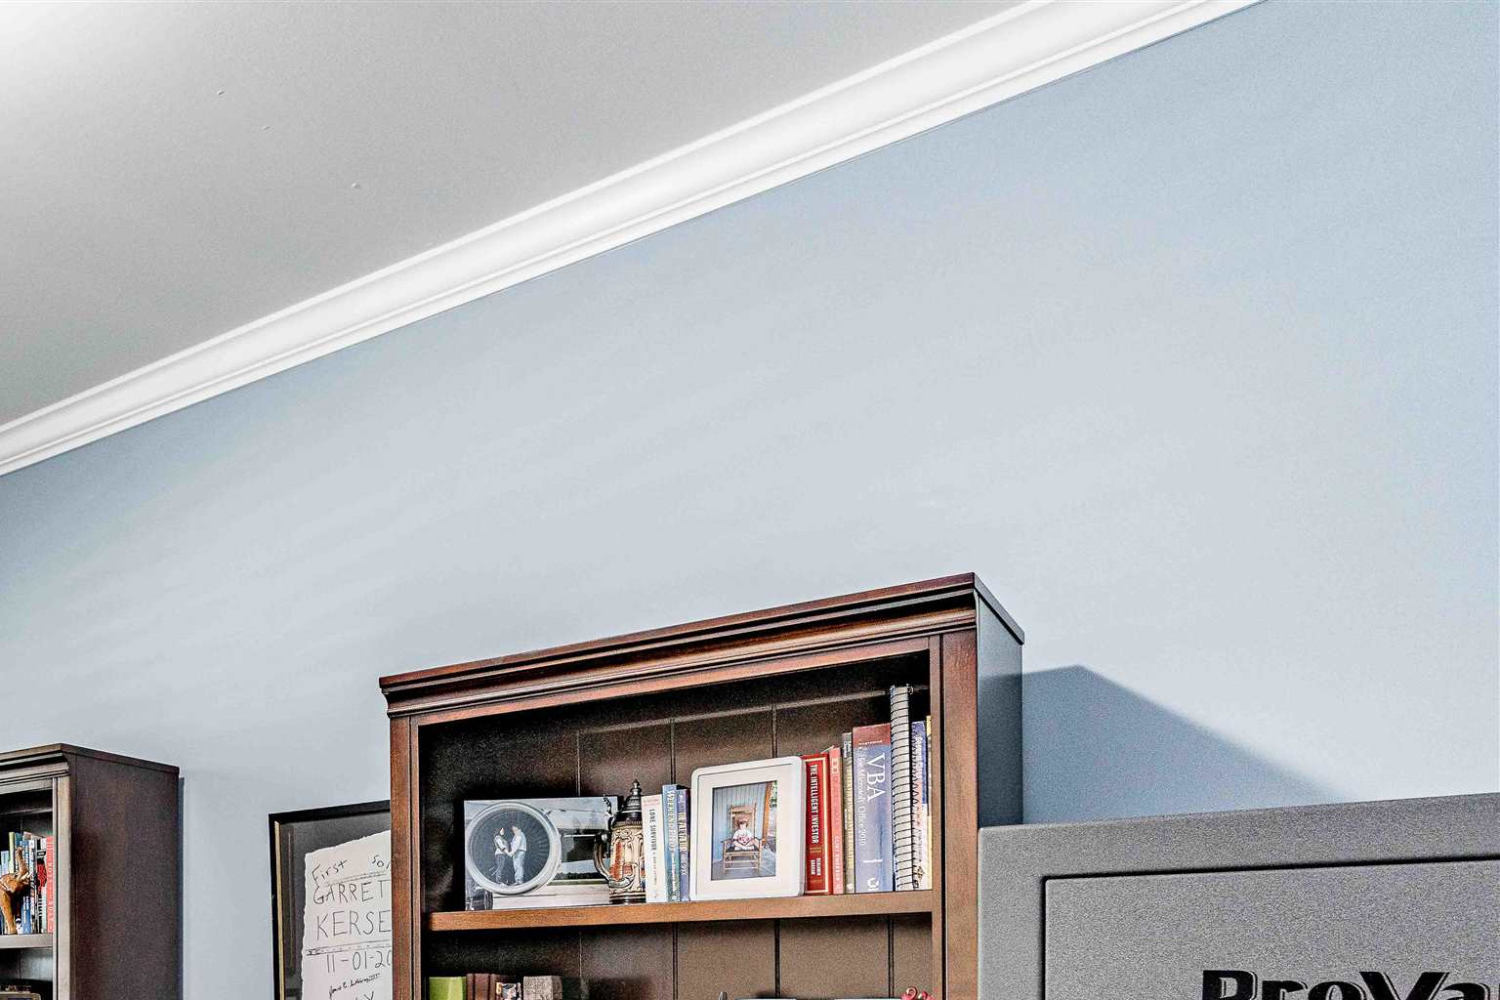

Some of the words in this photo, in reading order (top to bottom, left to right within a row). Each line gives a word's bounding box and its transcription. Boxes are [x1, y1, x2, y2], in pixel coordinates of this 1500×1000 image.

[810, 764, 818, 776] THE
[867, 752, 886, 802] VBA
[810, 776, 819, 814] INTELLIGENT
[811, 814, 820, 844] INVESTOR
[858, 804, 866, 828] Office
[311, 859, 348, 886] First
[372, 855, 391, 870] So
[312, 880, 391, 905] GARRET
[316, 909, 391, 942] KERSE
